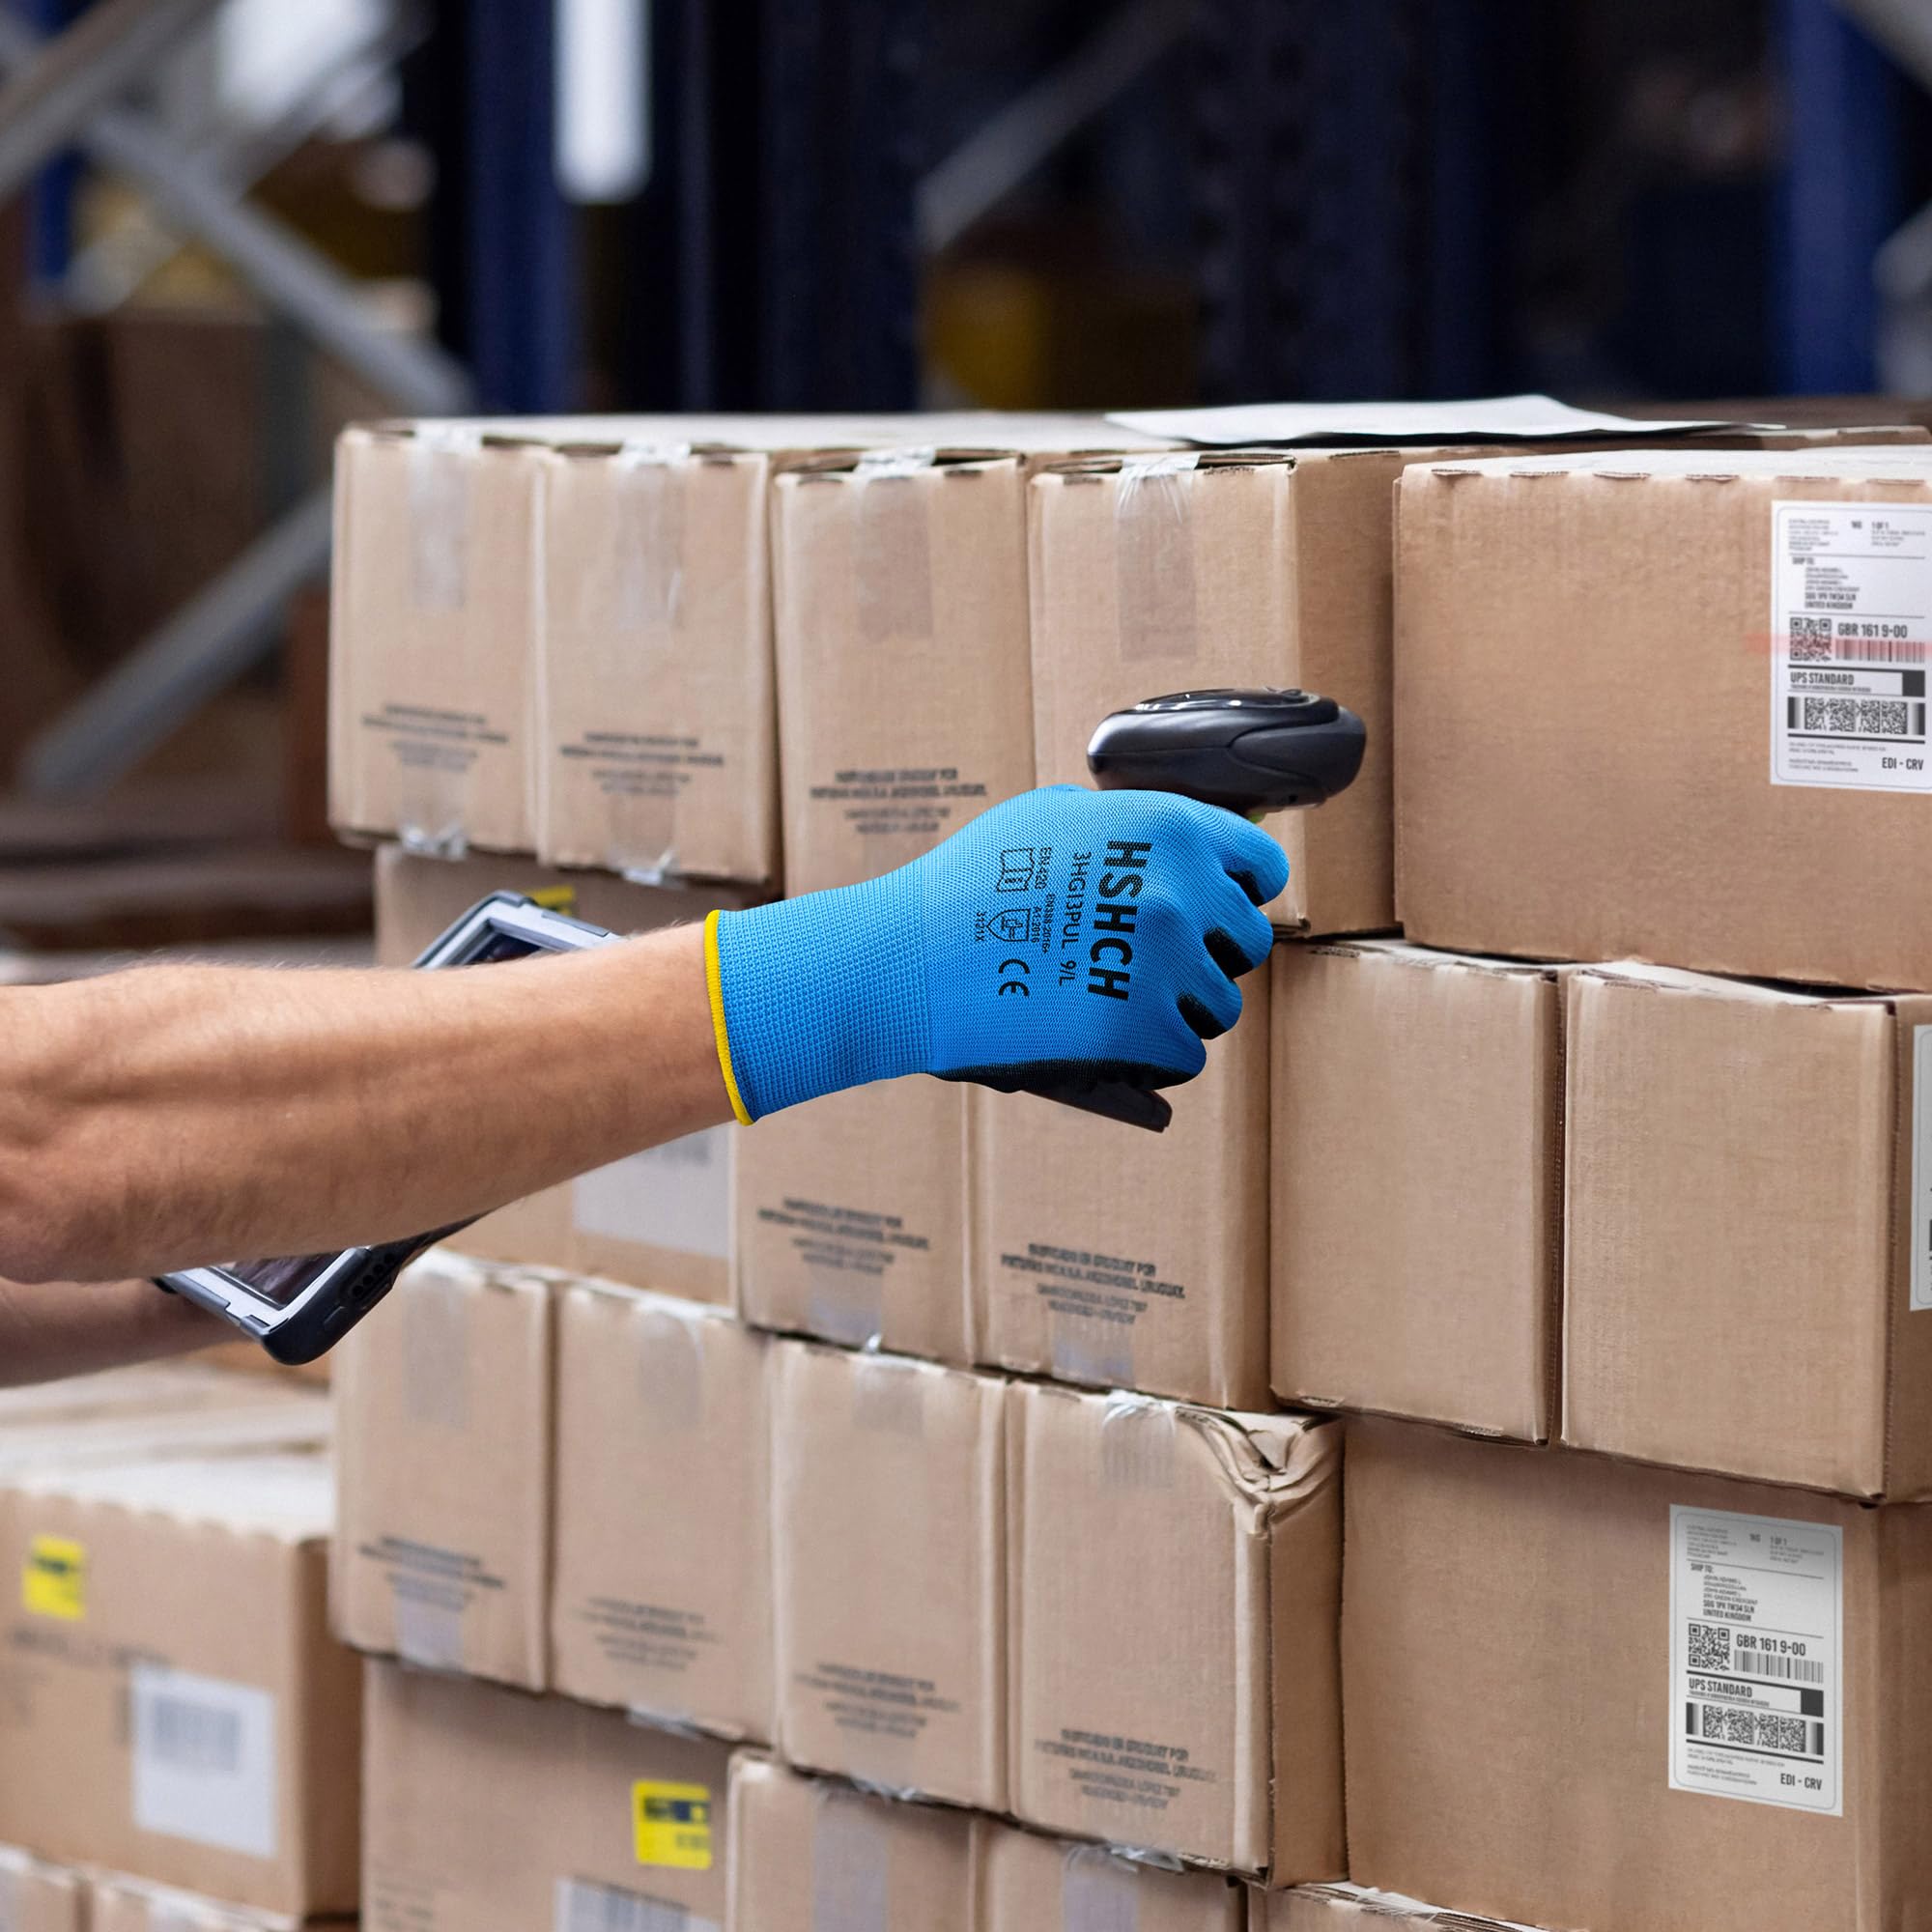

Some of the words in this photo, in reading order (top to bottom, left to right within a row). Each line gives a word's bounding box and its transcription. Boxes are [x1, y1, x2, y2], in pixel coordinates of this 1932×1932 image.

[1837, 622, 1859, 637] GBR
[1861, 624, 1879, 638] 161
[1882, 624, 1908, 639] 9-00
[1790, 672, 1807, 684] UPS
[1808, 673, 1855, 686] STANDARD
[1882, 757, 1897, 769] EDI
[1905, 758, 1924, 771] CRV
[1088, 840, 1152, 1002] HSHCH
[1059, 959, 1077, 986] 9/L
[1703, 1608, 1723, 1619] UNITED
[1724, 1611, 1751, 1623] KINGDOM
[1737, 1634, 1757, 1650] GBR
[1760, 1637, 1777, 1653] 161
[1779, 1640, 1806, 1657] 9-00
[1689, 1677, 1706, 1690] UPS
[1707, 1681, 1752, 1698] STANDARD
[1780, 1773, 1795, 1786] EDI
[1804, 1776, 1822, 1791] CRV
